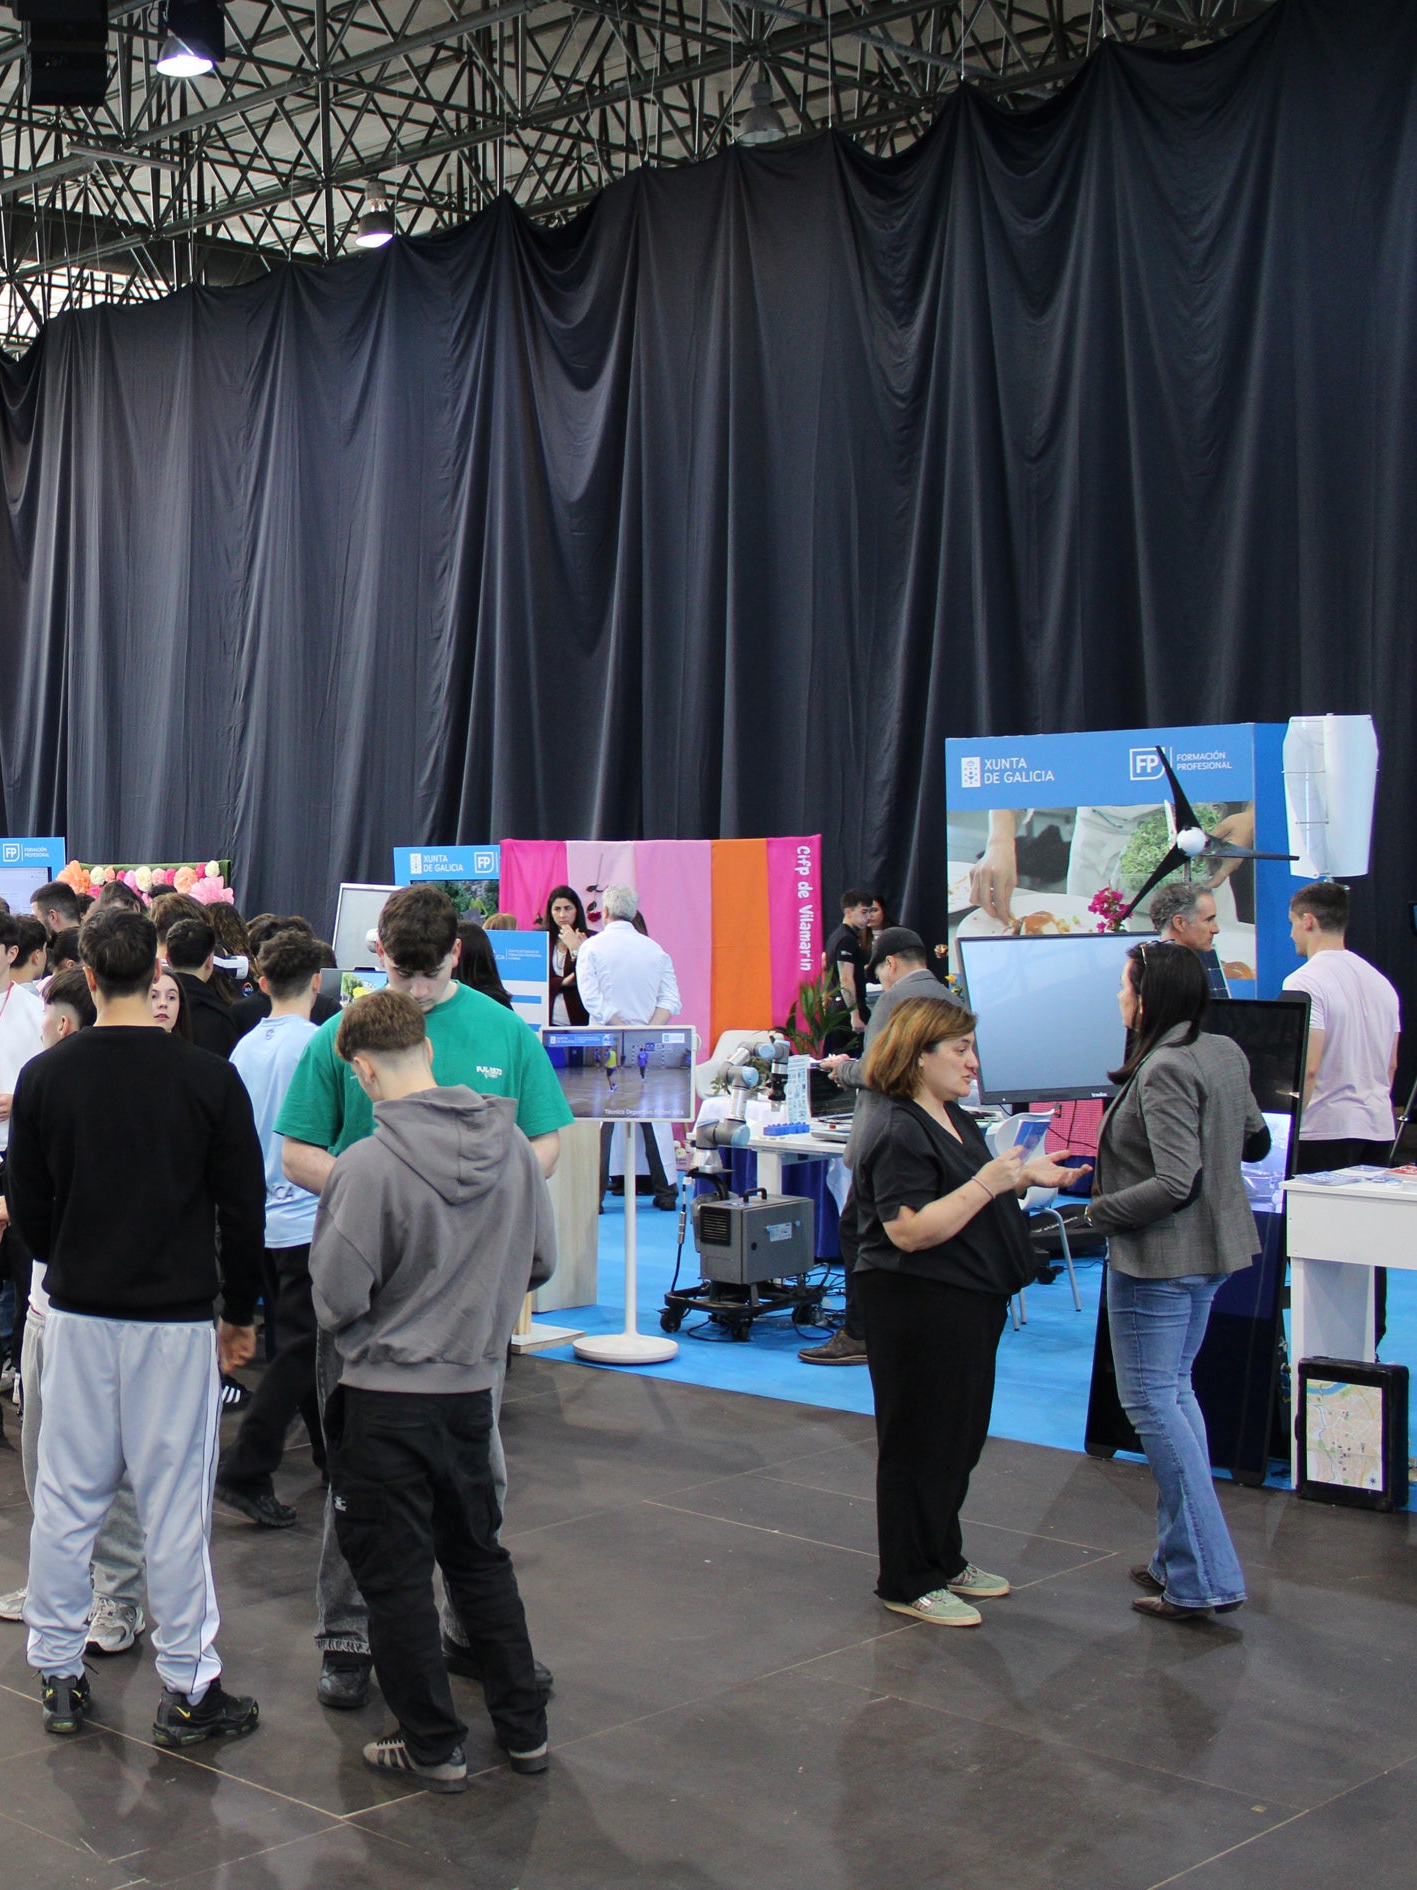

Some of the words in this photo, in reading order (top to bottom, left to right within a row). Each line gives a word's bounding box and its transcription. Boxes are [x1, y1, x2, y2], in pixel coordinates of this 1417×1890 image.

[1176, 750, 1226, 762] FORMACIÓN
[984, 758, 1028, 770] XUNTA
[1135, 754, 1160, 774] FP
[1176, 762, 1233, 771] PROFESIONAL
[984, 772, 1001, 784] DE
[1003, 770, 1055, 783] GALICIA
[5, 848, 17, 858] FP
[423, 854, 448, 863] XUNTA
[477, 856, 491, 869] FP
[794, 845, 812, 876] Cifp
[423, 864, 433, 873] DE
[434, 863, 464, 873] GALICIA
[797, 881, 813, 899] de
